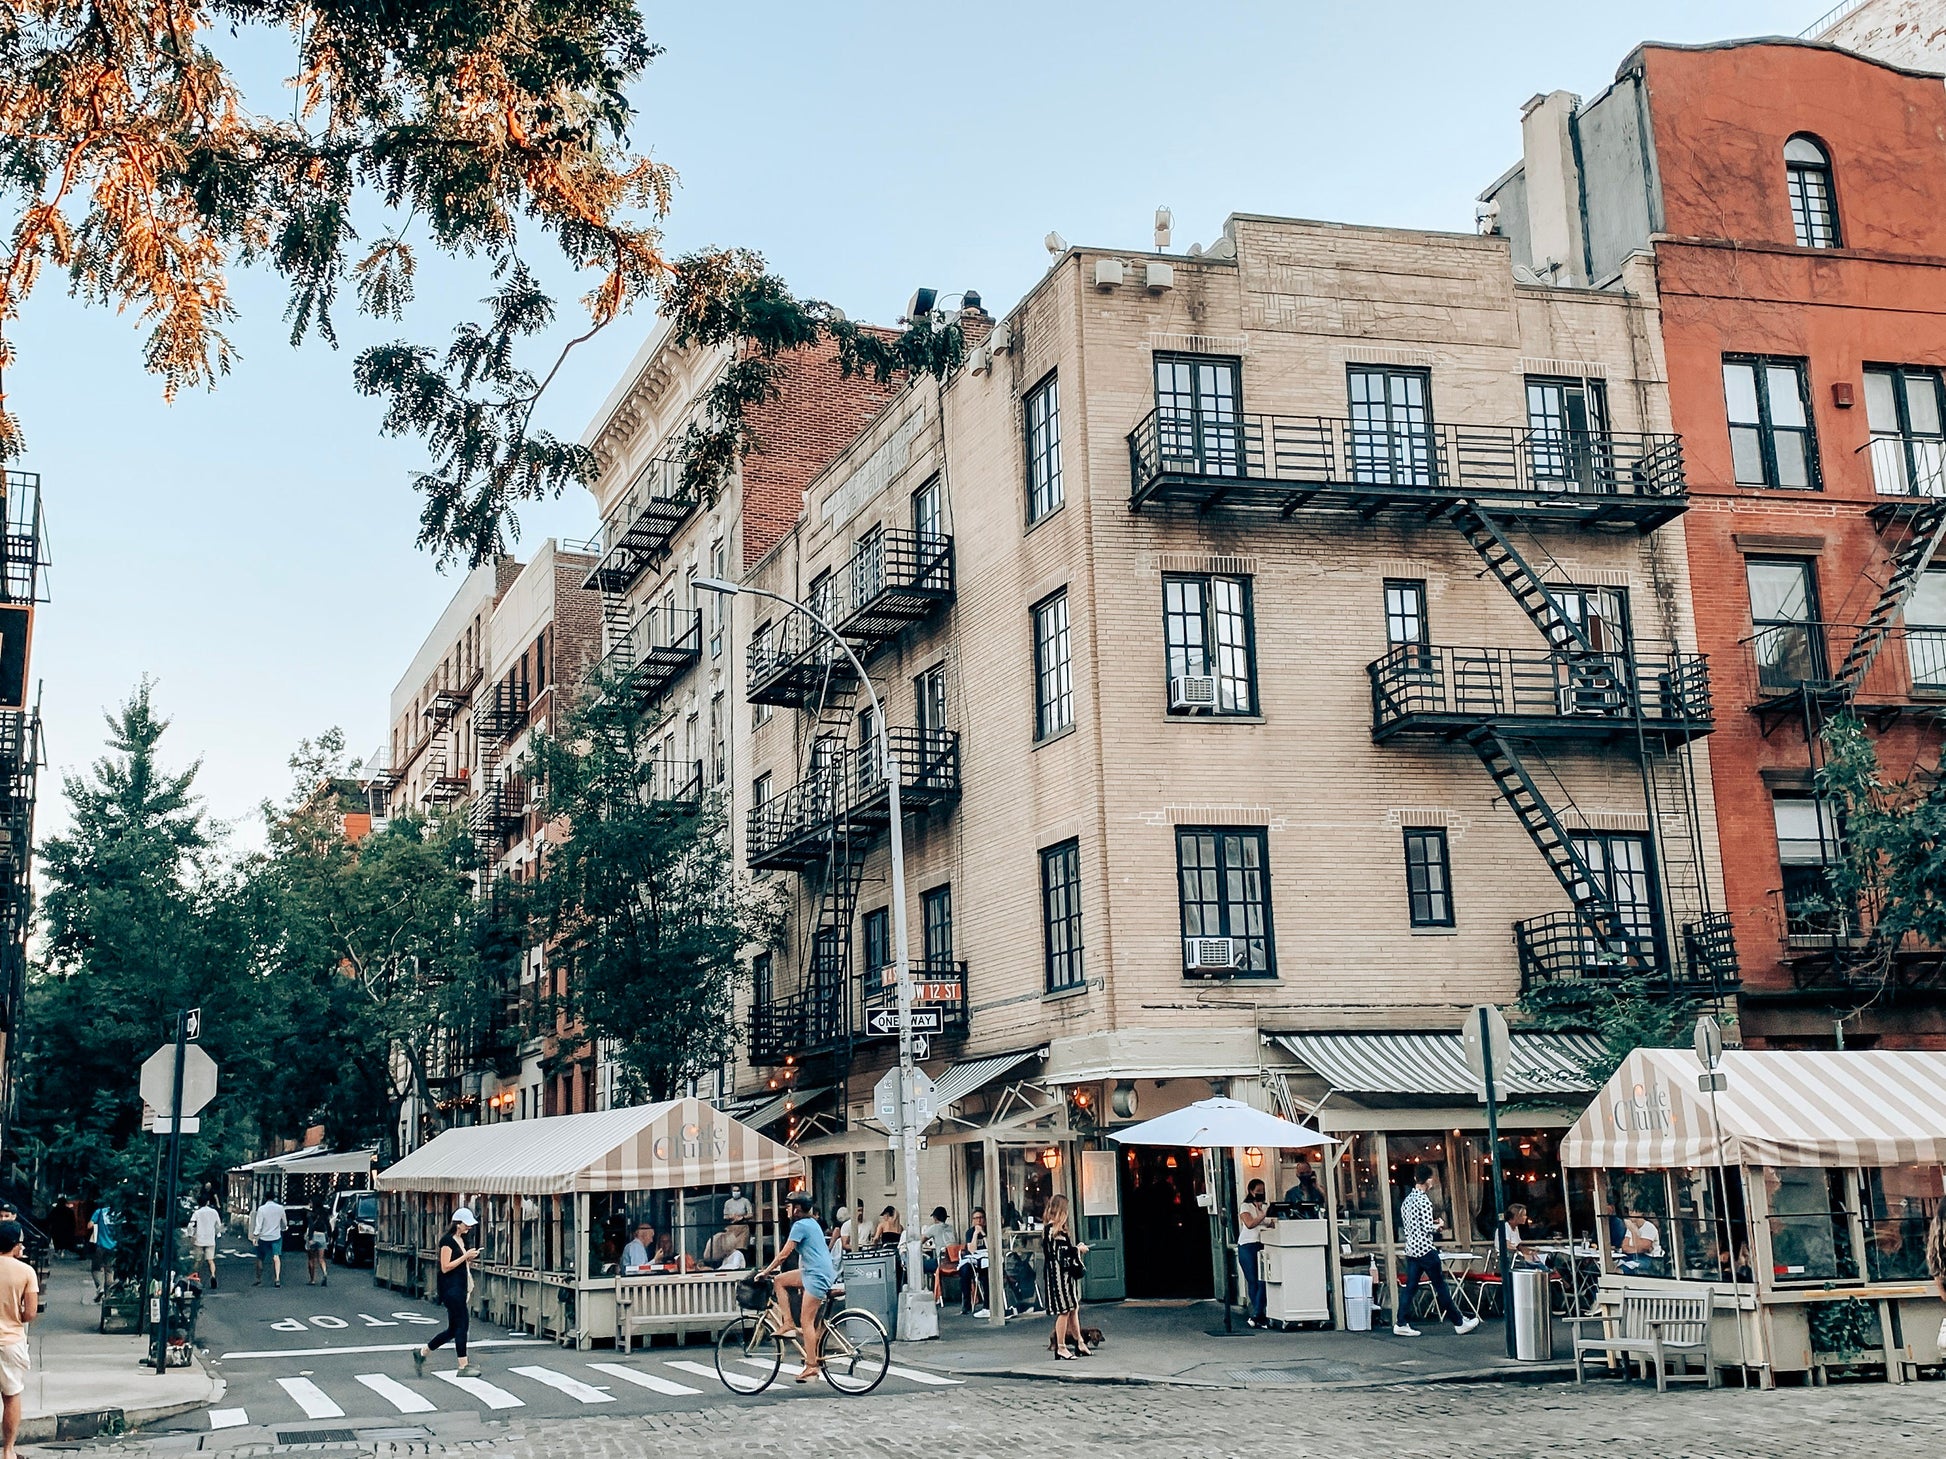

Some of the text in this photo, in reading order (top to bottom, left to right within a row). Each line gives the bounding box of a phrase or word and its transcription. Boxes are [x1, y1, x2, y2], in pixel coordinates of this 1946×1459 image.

[916, 984, 956, 998] W 12 ST
[878, 1016, 932, 1026] ONE WAY
[1614, 1098, 1670, 1137] Cluny
[654, 1137, 726, 1162] Cluny
[270, 1311, 440, 1332] STOP
